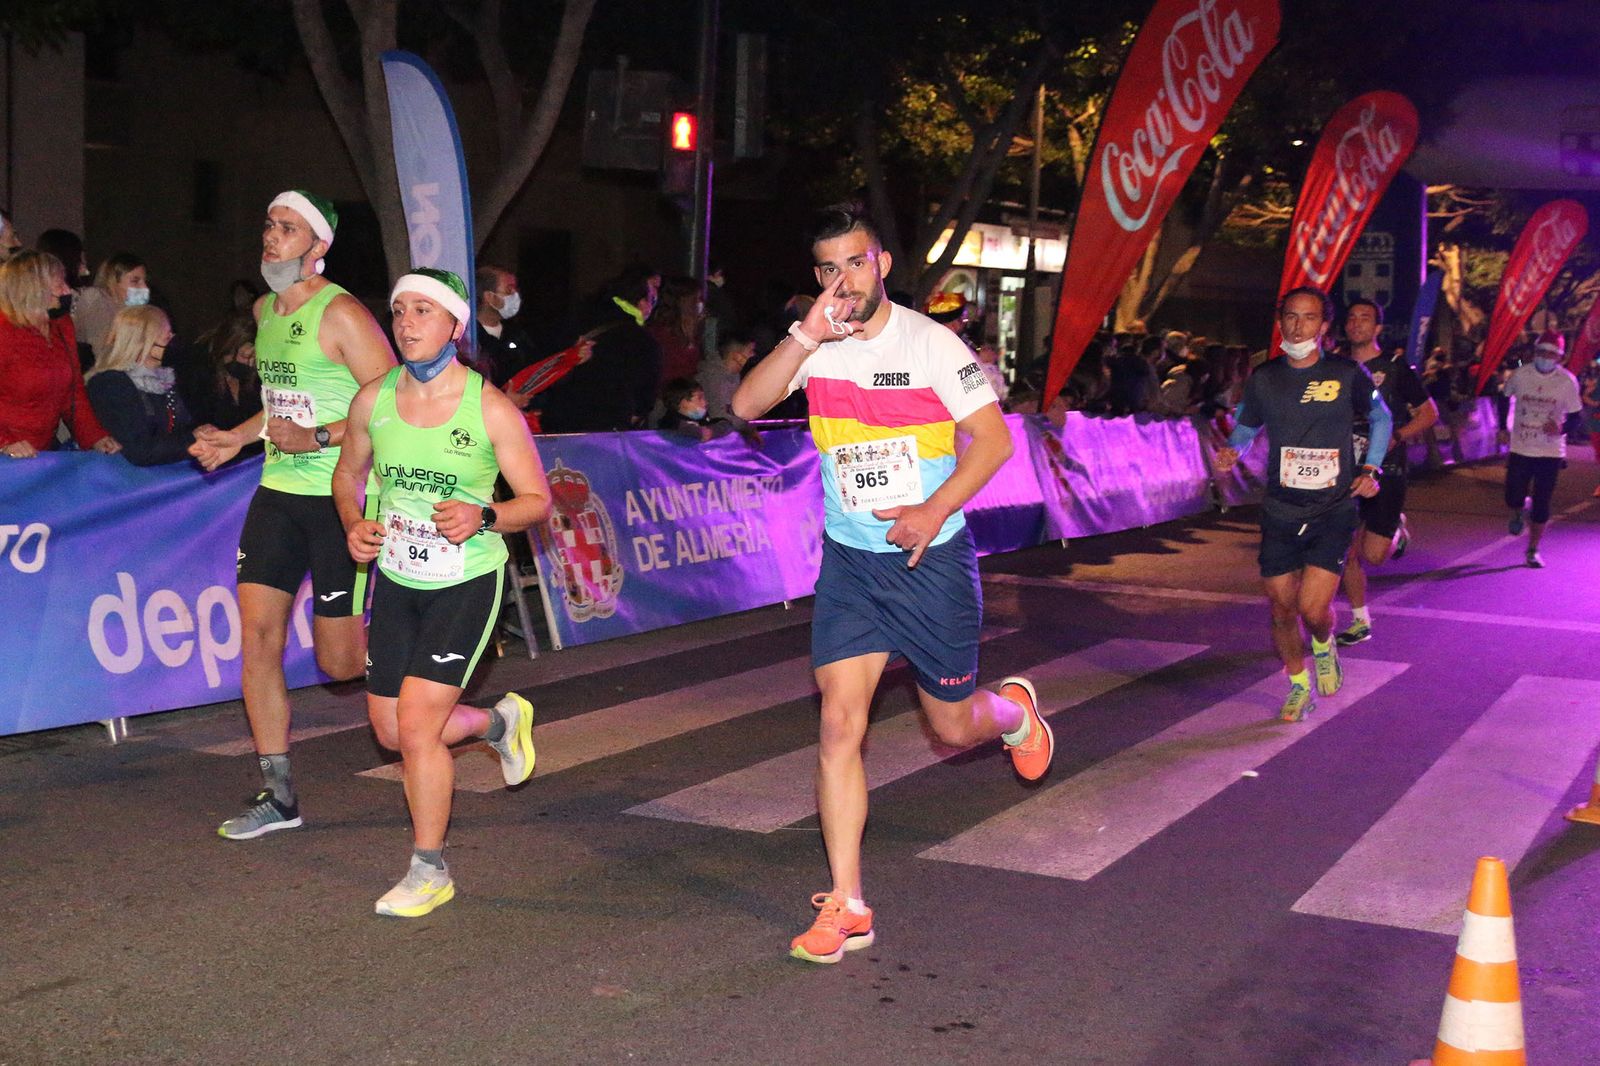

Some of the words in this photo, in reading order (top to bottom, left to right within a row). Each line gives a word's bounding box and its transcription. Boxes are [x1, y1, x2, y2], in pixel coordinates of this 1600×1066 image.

[1101, 0, 1254, 232] Coca-Cola
[1296, 102, 1400, 285] Coca-Cola
[263, 372, 297, 387] Running
[873, 372, 910, 387] 226ERS
[378, 462, 458, 486] Universo
[855, 470, 889, 489] 965
[1297, 465, 1320, 477] 259
[395, 479, 455, 499] Running
[408, 545, 429, 562] 94
[632, 533, 671, 572] DE
